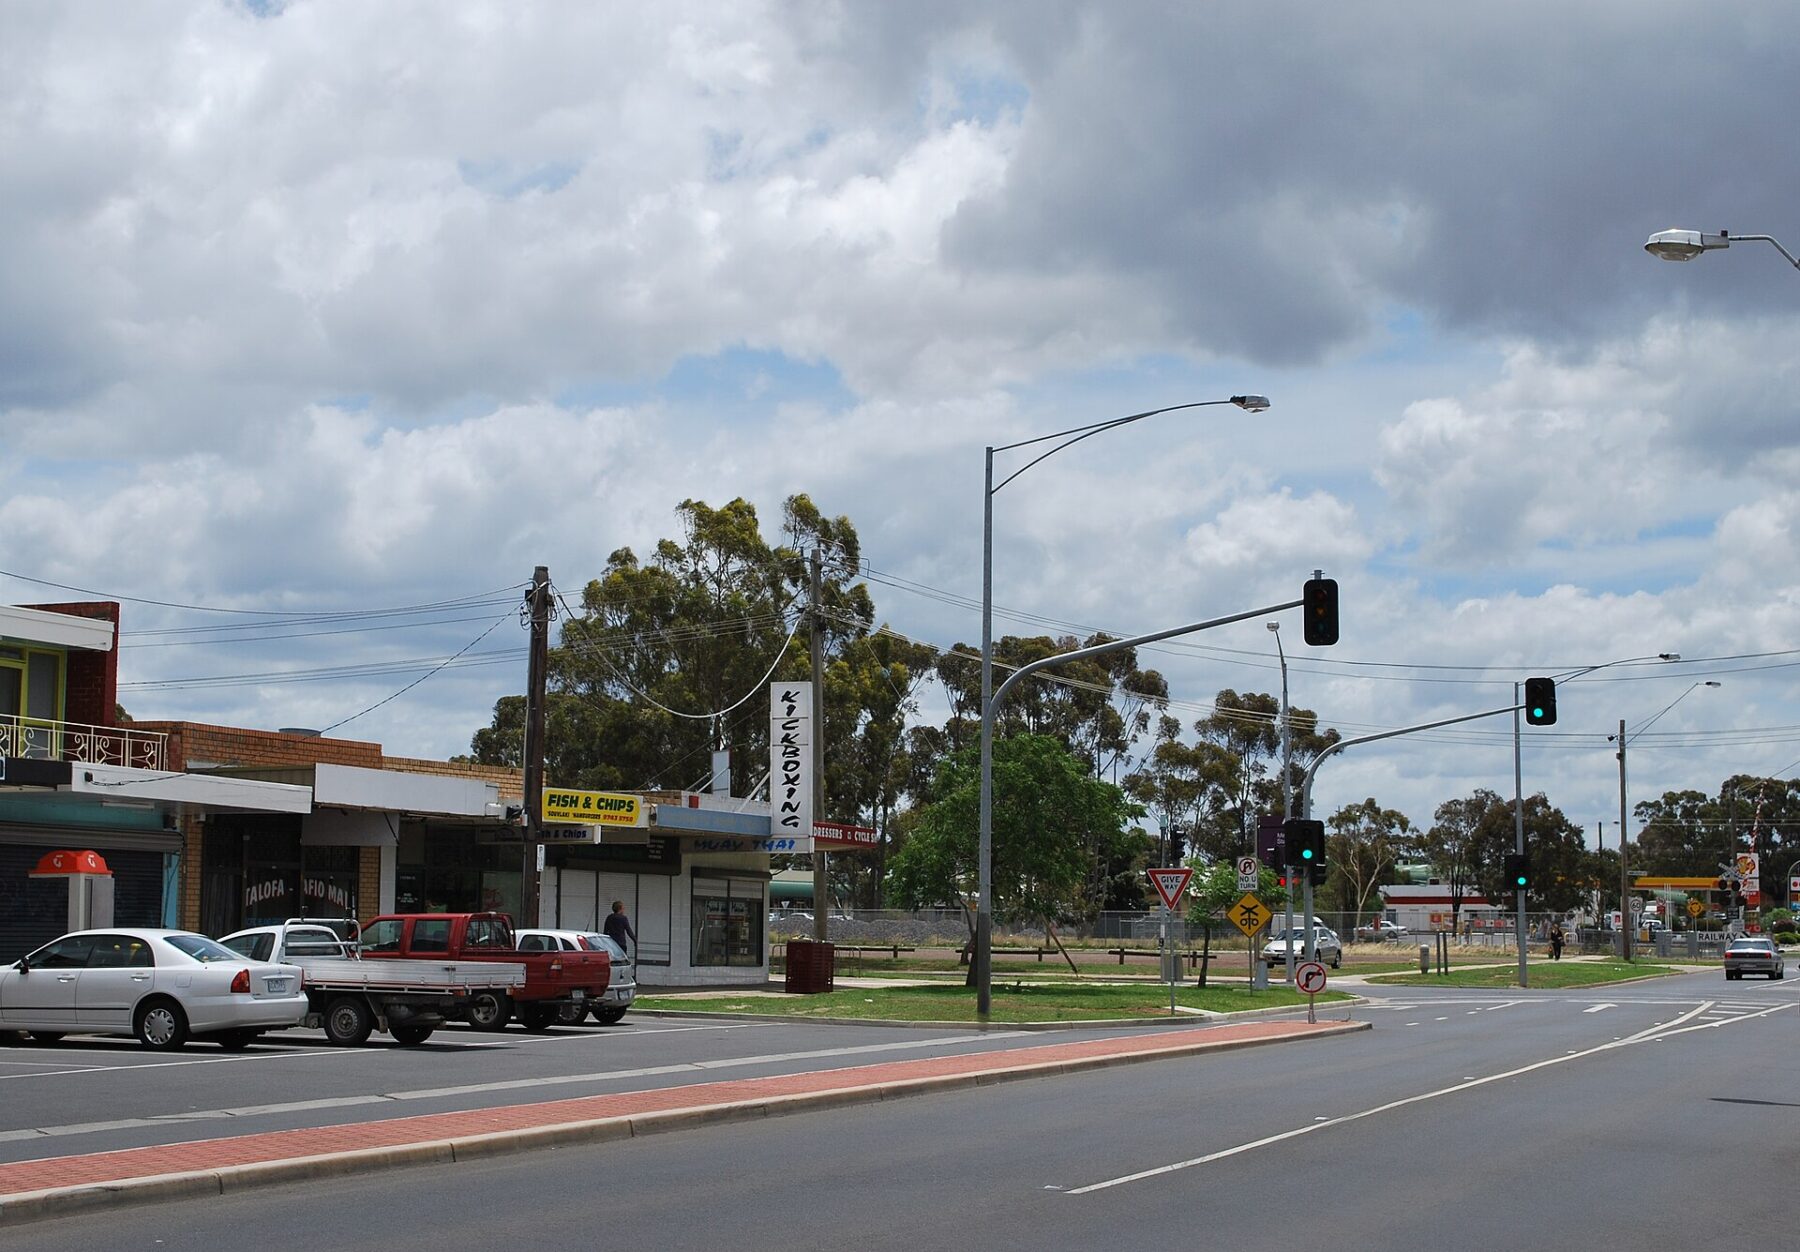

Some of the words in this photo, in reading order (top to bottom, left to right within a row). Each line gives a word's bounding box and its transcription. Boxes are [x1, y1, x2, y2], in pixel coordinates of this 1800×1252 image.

[780, 690, 800, 828] KICKBOXING
[547, 794, 579, 808] FISH
[582, 796, 592, 809] &
[597, 797, 634, 812] CHIPS
[752, 838, 795, 852] THAI
[1632, 901, 1640, 909] 60
